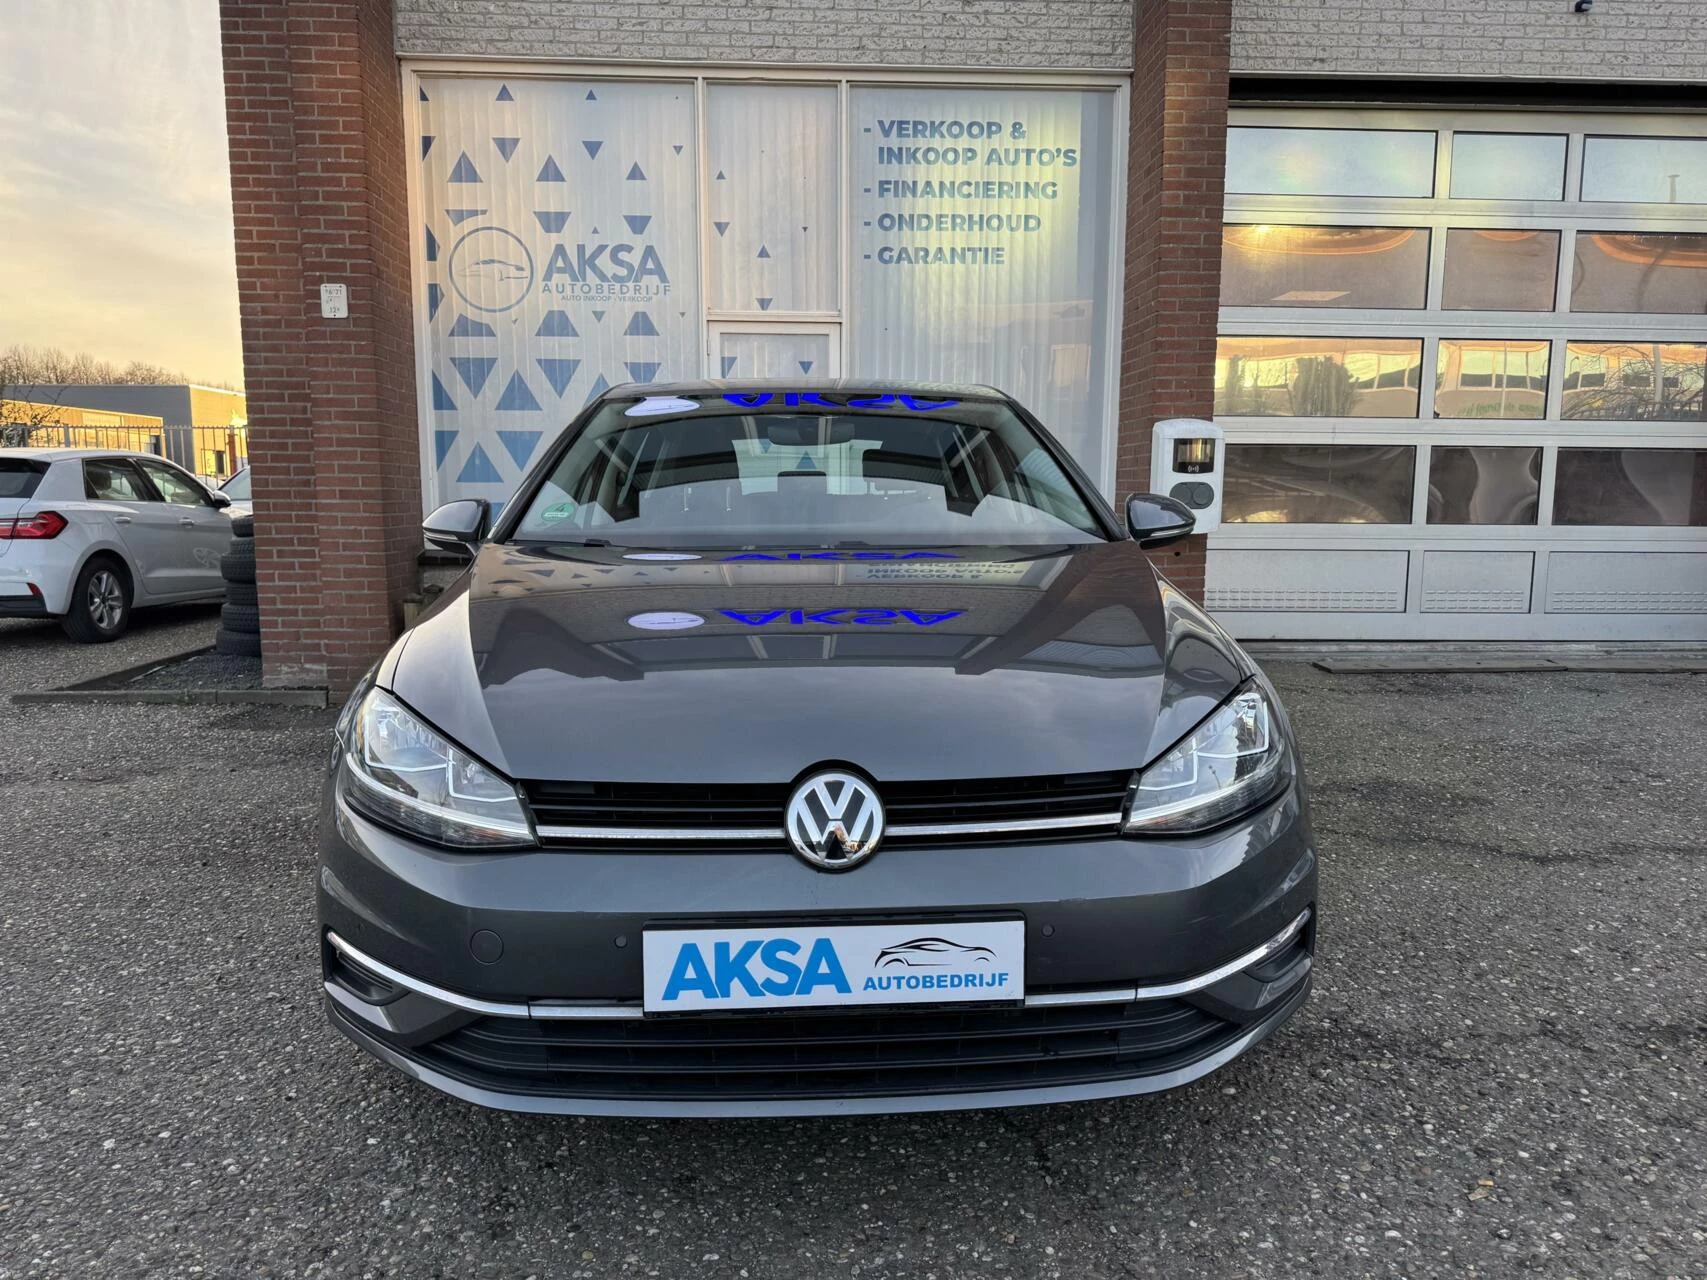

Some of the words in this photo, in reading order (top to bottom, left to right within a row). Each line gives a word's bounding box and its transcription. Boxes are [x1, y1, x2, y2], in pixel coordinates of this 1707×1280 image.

[877, 120, 1002, 139] VERKOOP
[1009, 122, 1026, 140] &
[878, 147, 978, 165] INKOOP
[878, 180, 1058, 199] FINANCIERING
[877, 213, 1041, 232] ONDERHOUD
[542, 243, 671, 284] AKSA
[877, 246, 1005, 265] GARANTIE
[542, 283, 672, 296] AUTOBEDRIJF
[662, 937, 852, 1000] AKSA
[863, 972, 1009, 991] AUTOBEDRIJF
